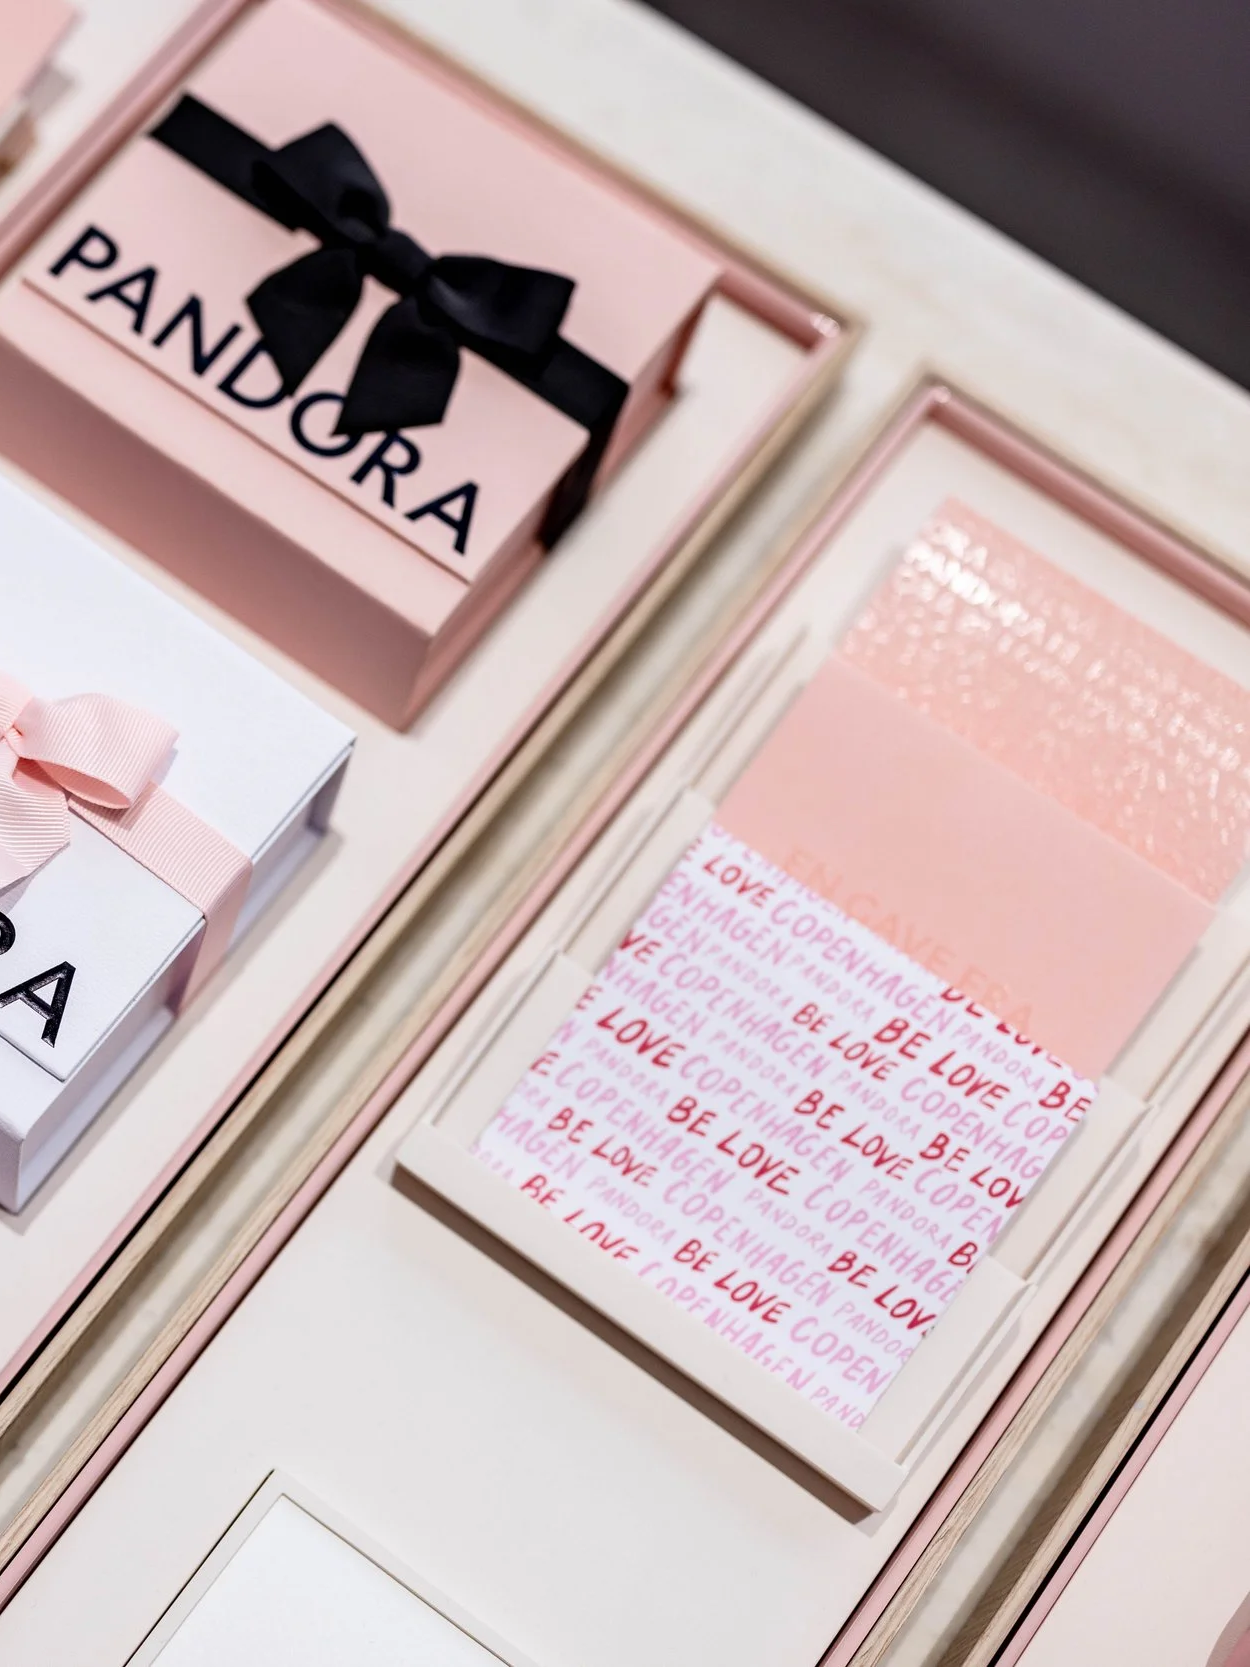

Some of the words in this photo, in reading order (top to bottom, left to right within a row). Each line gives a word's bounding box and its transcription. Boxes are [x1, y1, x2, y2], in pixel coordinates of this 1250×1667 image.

[48, 224, 480, 557] PANDORA
[617, 930, 661, 960] VE
[656, 951, 830, 1078] COPENHAGEN
[918, 1131, 969, 1171] BE
[969, 1167, 1023, 1208] LOV
[702, 856, 774, 906] LOVE
[769, 900, 952, 1033] COPENHAGEN
[1037, 1080, 1090, 1121] BE
[872, 1017, 930, 1060] BE
[927, 1050, 1009, 1109] LOVE
[1001, 1100, 1069, 1144] COP
[595, 1008, 685, 1068] LOVE
[678, 1054, 851, 1187] COPENHAGEN
[947, 1240, 978, 1272] B
[666, 1095, 716, 1137] BE
[715, 1131, 798, 1195] LOVE
[792, 1002, 825, 1033] BE
[828, 1033, 897, 1081] LOVE
[900, 1076, 1044, 1179] COPENHAG
[793, 1088, 844, 1130] BE
[839, 1124, 913, 1180] LOVE
[529, 1051, 559, 1076] E
[554, 1061, 734, 1193] COPENHAGEN
[827, 1250, 876, 1288] BE
[873, 1285, 938, 1340] LOV
[546, 1106, 593, 1144] BE
[590, 1139, 656, 1185] LOVE
[662, 1175, 832, 1306] COPENHAGEN
[672, 1238, 716, 1272] BE
[712, 1271, 790, 1323] LOVE
[788, 1315, 890, 1393] COPEN
